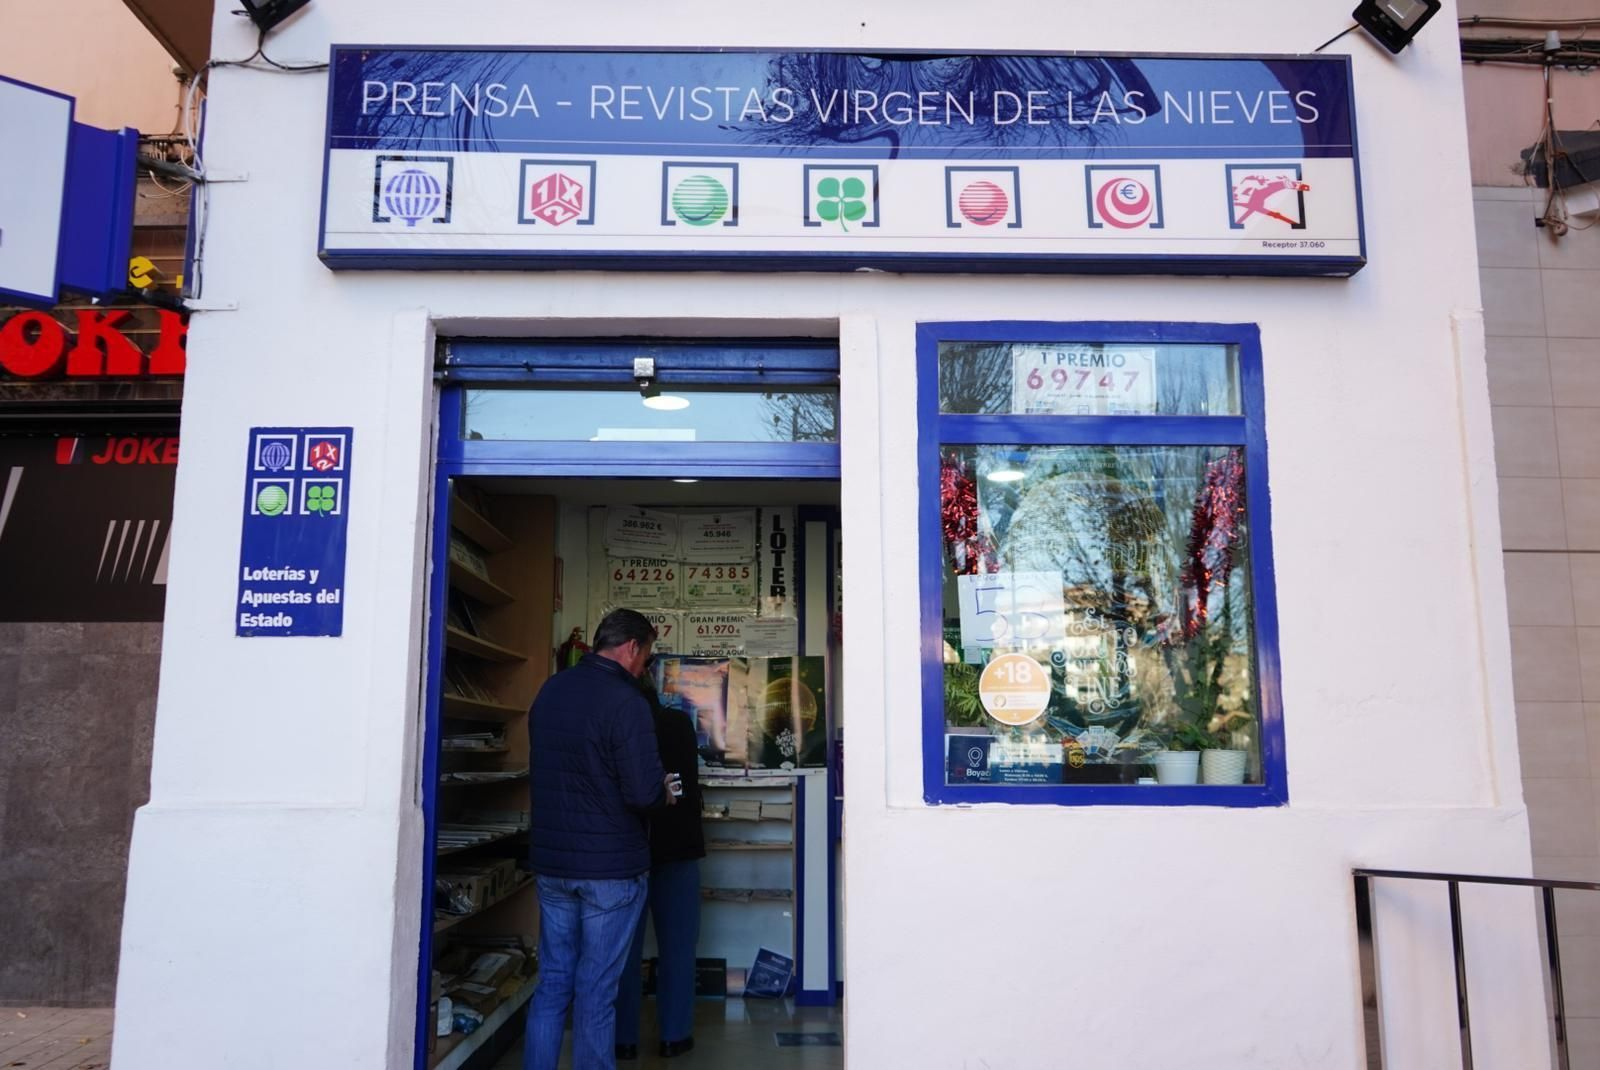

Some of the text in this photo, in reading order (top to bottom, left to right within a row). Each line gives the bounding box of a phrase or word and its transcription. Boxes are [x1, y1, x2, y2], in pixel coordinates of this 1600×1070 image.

[361, 81, 540, 118] PRENSA
[590, 85, 794, 122] REVISTAS
[812, 89, 975, 125] VIRGEN
[994, 91, 1050, 125] DE
[1067, 91, 1147, 124] LAS
[1164, 91, 1320, 124] NIEVES
[1262, 241, 1326, 249] Receptor 37.060
[1057, 353, 1126, 367] PREMIO
[1027, 368, 1139, 392] 69747
[92, 437, 180, 464] JOKE
[243, 566, 320, 585] Loterías y
[614, 568, 675, 581] 64226
[689, 567, 750, 579] 74385
[241, 588, 341, 608] Apuestas del
[240, 612, 293, 627] Estado
[697, 625, 735, 634] 61.970
[993, 661, 1032, 684] +18
